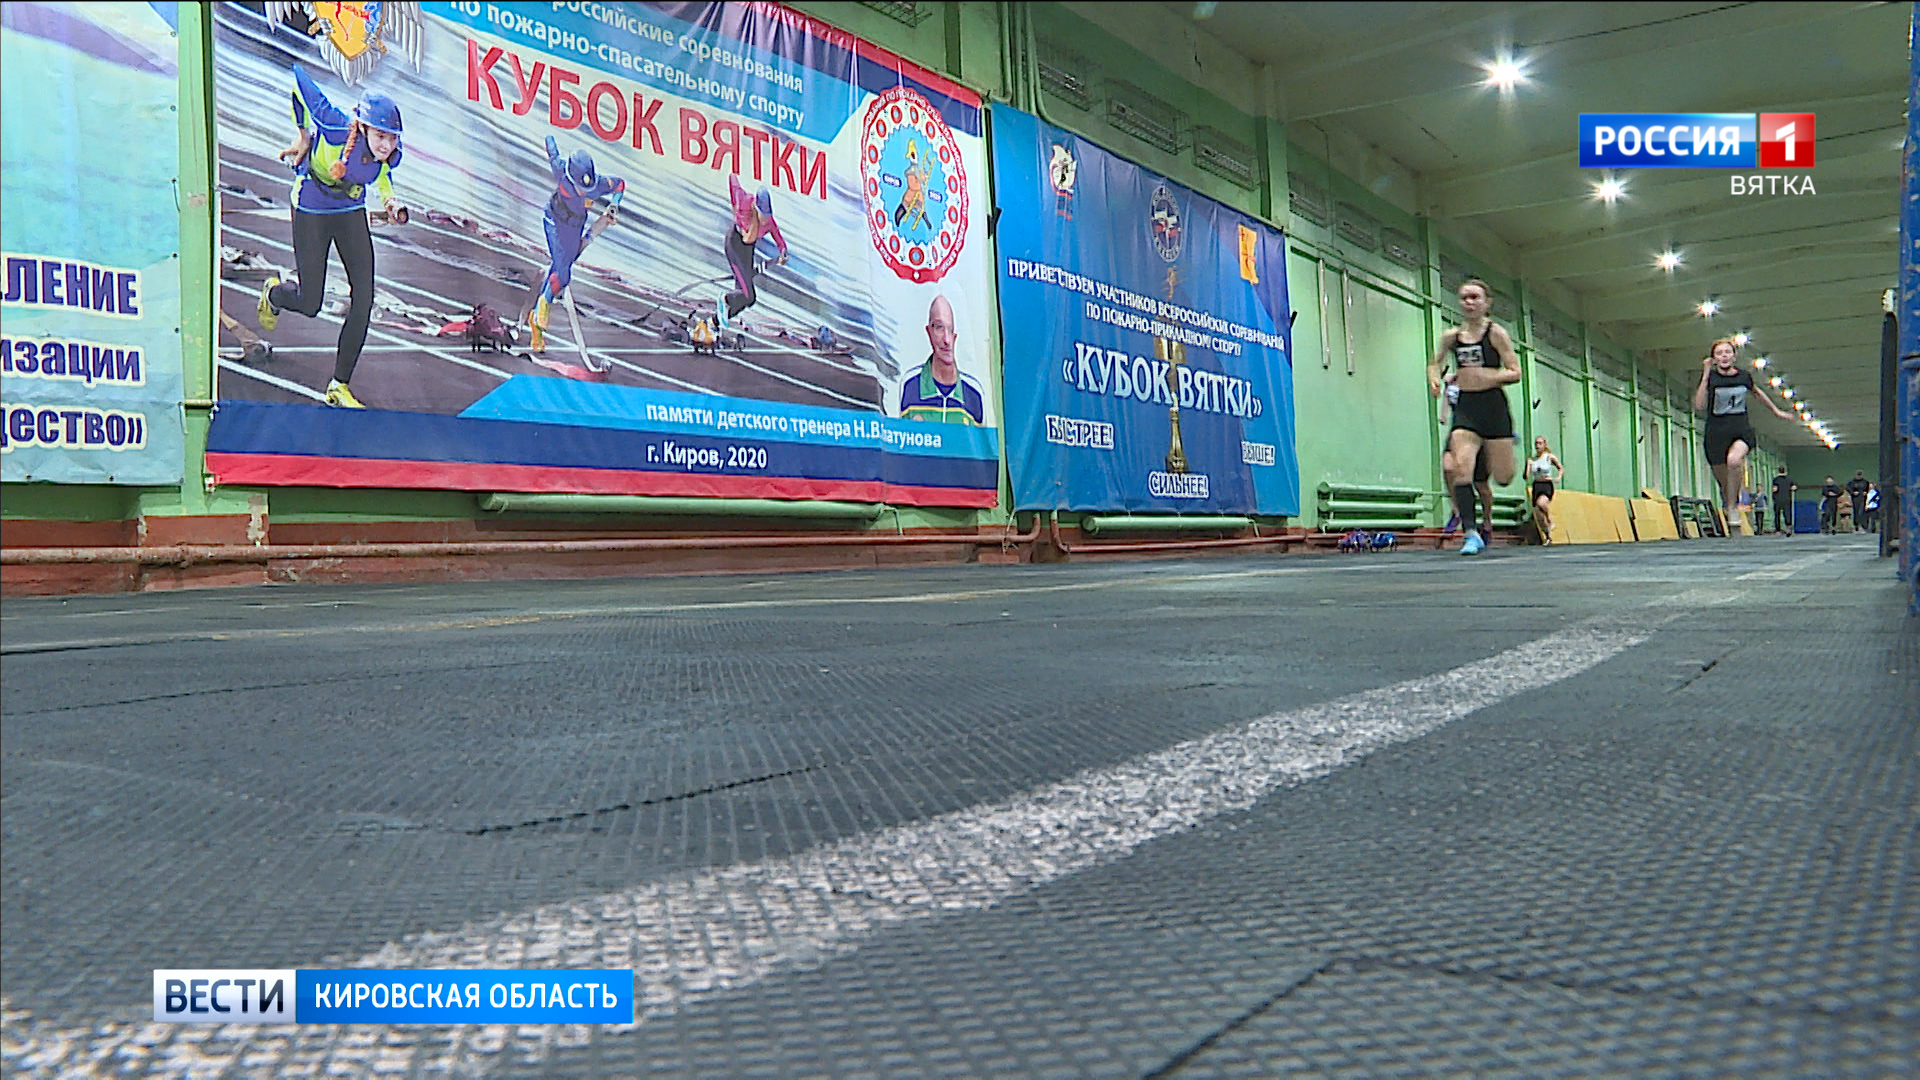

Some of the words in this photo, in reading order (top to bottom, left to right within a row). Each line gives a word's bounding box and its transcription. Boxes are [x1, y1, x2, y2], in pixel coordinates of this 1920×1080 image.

[487, 4, 745, 109] пожарно-спасательному
[749, 94, 804, 130] спорту
[678, 35, 803, 93] соревнования
[467, 38, 664, 155] КУБОК
[679, 107, 827, 199] ВЯТКИ
[1, 257, 139, 315] ЛЕНИЕ
[1086, 301, 1100, 320] ПО
[1063, 342, 1173, 404] «КУБОК
[1176, 366, 1262, 417] ВЯТКИ»
[1, 407, 142, 447] ество»
[646, 404, 713, 425] памяти
[717, 411, 788, 431] детского
[792, 417, 850, 440] тренера
[1047, 417, 1113, 447] БЫСТРЕЕ!
[647, 446, 659, 463] г.
[664, 442, 724, 469] Киров,
[727, 446, 768, 468] 2020
[1150, 472, 1208, 497] СИЛЬНЕЕ!
